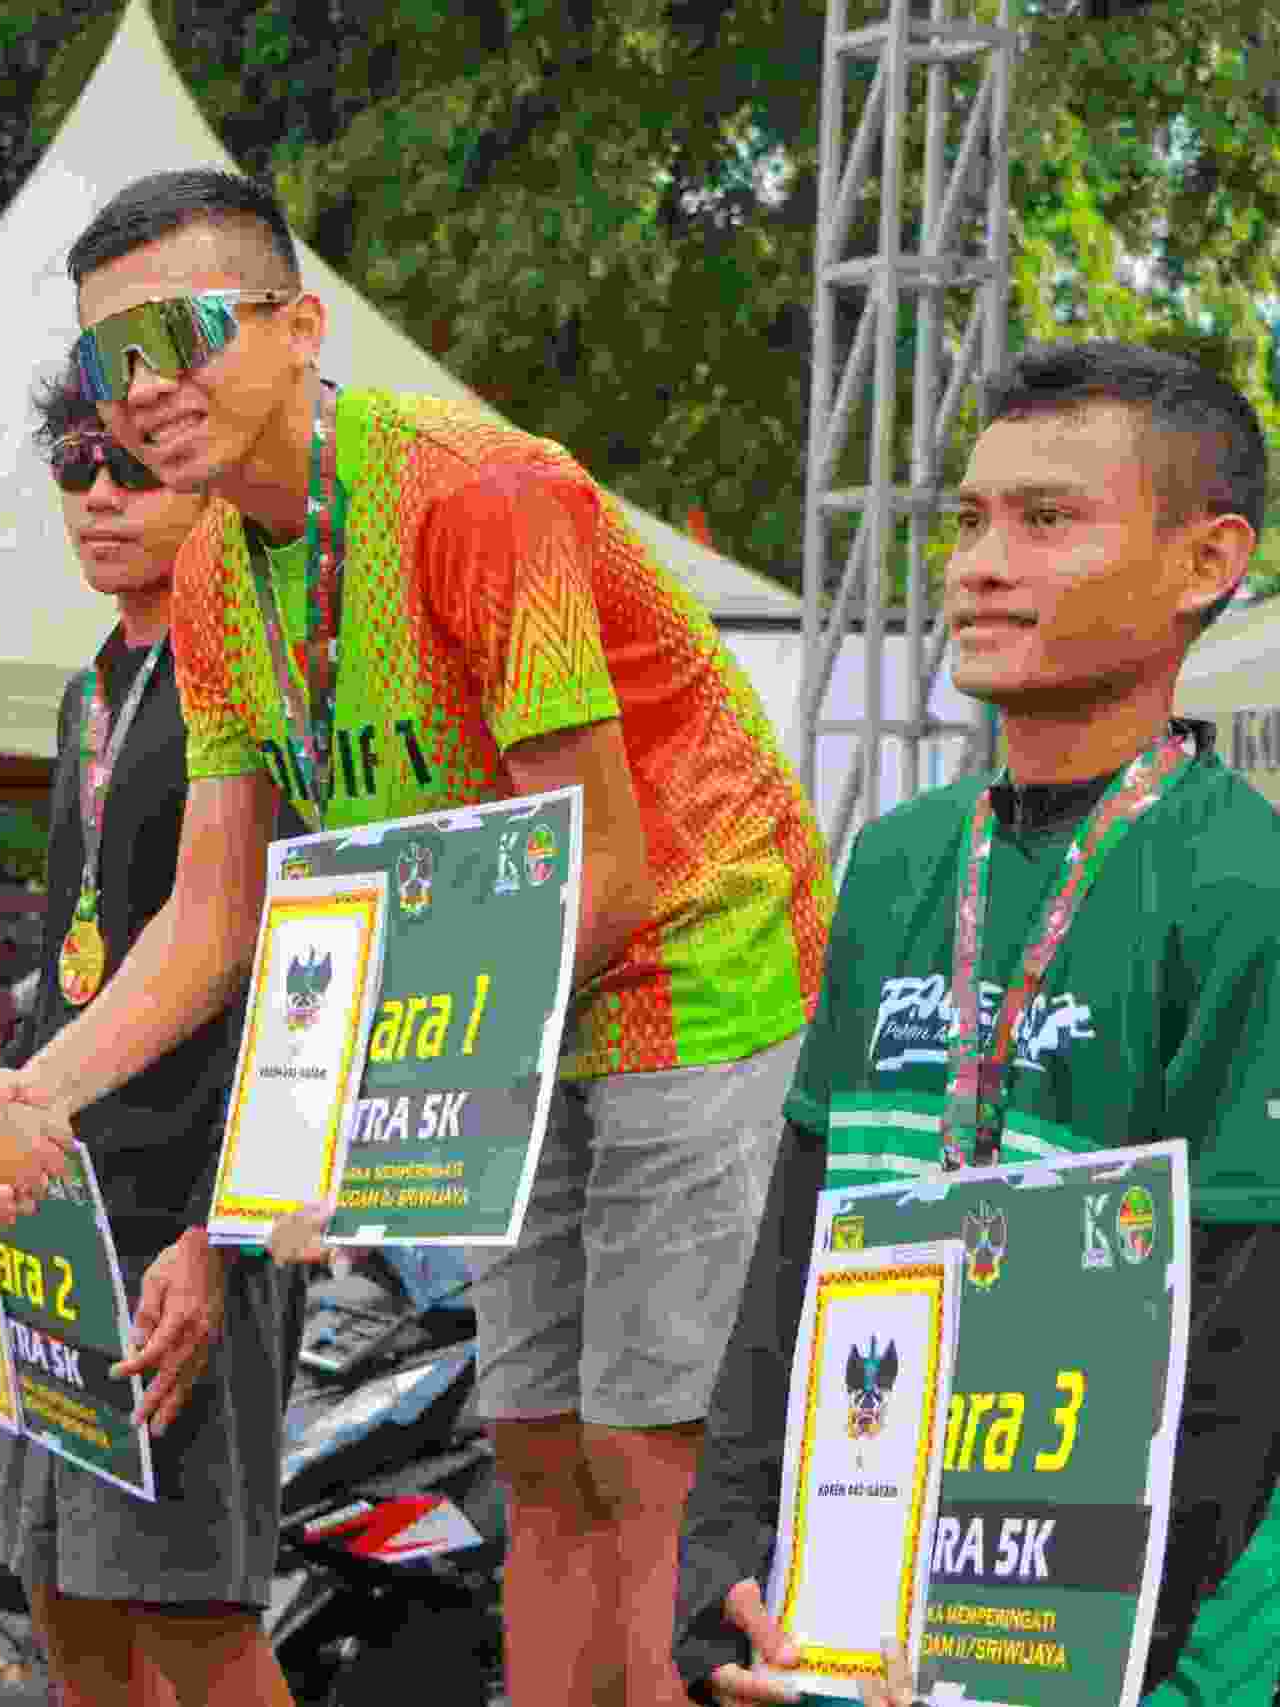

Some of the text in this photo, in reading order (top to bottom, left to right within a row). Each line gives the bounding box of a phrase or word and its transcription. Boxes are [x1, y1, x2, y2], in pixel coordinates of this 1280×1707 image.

[463, 974, 491, 1057] 1
[417, 1088, 470, 1141] 5K
[53, 1255, 77, 1321] 2
[1034, 1369, 1088, 1472] 3
[995, 1515, 1056, 1579] 5K
